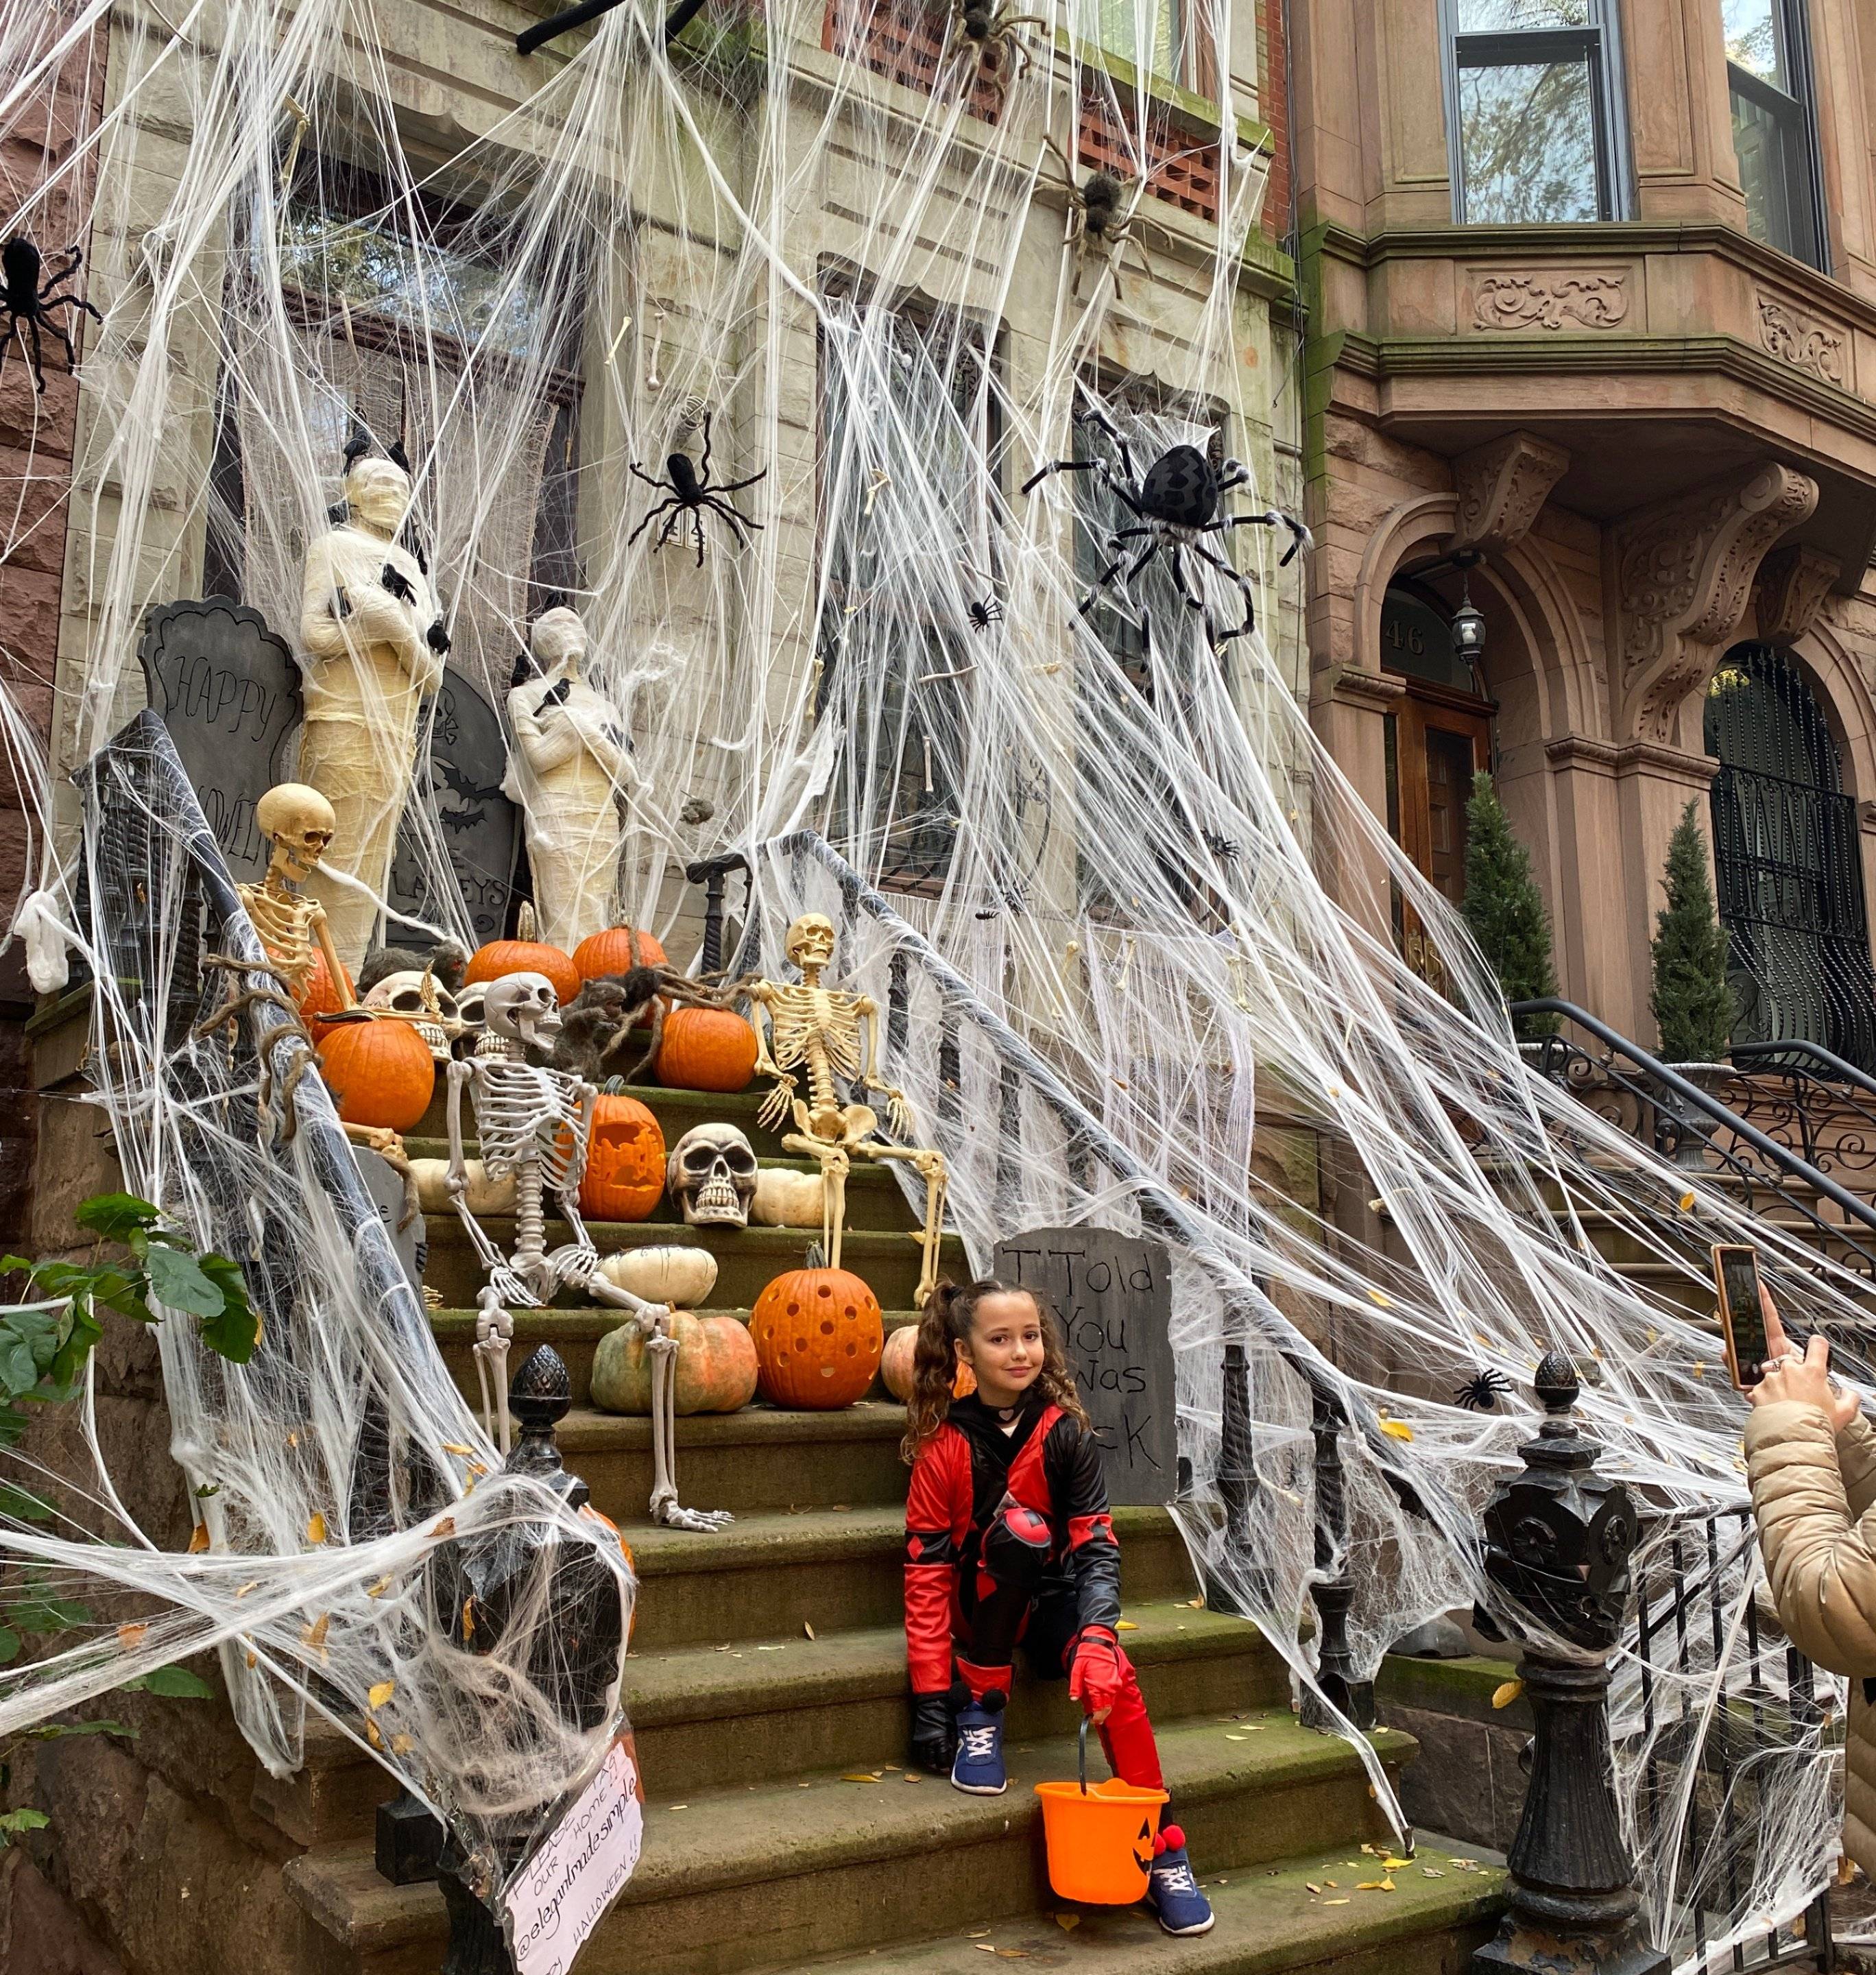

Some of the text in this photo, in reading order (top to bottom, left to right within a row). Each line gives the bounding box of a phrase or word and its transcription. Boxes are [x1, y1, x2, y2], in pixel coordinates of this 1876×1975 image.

[1385, 619, 1424, 655] 46
[169, 656, 277, 743] HAPPY
[1048, 1249, 1155, 1297] Told
[513, 1812, 575, 1900] PLEASE
[533, 1856, 559, 1897] OUR
[573, 1854, 627, 1946] HALLOWEEN
